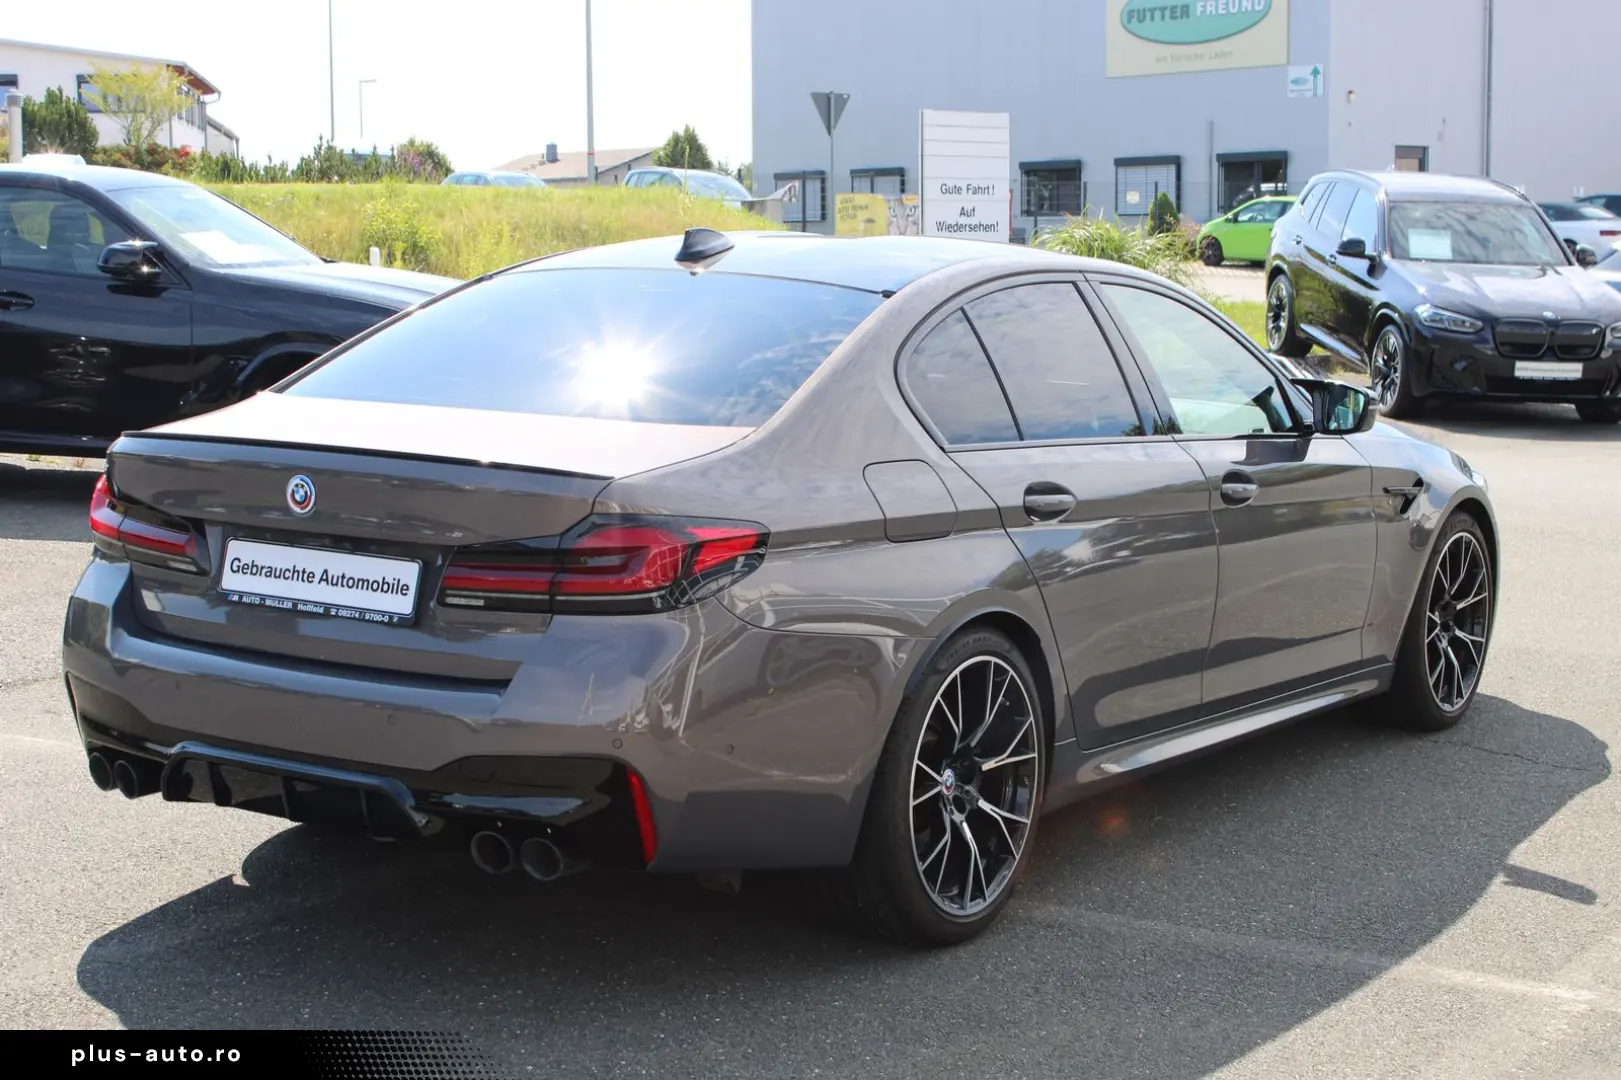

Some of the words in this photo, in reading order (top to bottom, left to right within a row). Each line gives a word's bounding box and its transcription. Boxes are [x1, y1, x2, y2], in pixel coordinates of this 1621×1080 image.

[1126, 4, 1190, 24] FUTTER
[1196, 0, 1265, 16] FREUND
[940, 183, 962, 195] Gute
[959, 206, 976, 218] Auf
[935, 221, 999, 233] Wiedersehen!
[230, 556, 315, 584] Gebrauchte
[318, 569, 410, 596] Automobile
[242, 595, 260, 605] AUTO
[338, 609, 359, 618] 09274
[365, 612, 389, 622] 9700-0
